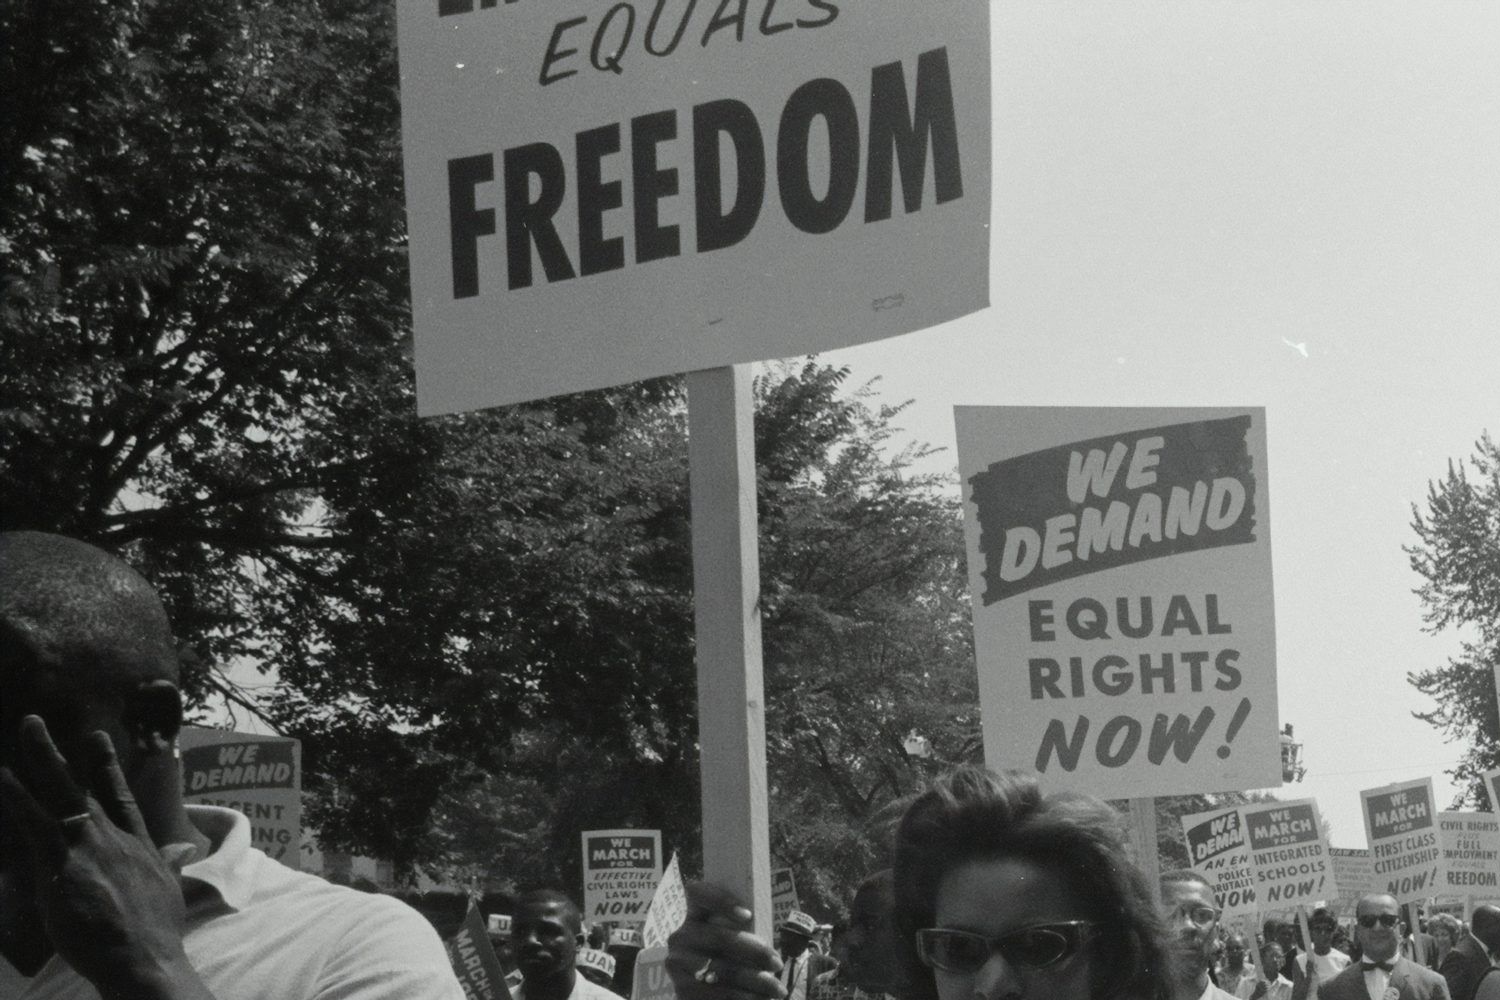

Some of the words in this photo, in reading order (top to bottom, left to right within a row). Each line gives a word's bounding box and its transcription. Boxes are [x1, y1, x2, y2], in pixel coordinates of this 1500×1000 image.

[448, 46, 964, 299] FREEDOM
[1067, 436, 1164, 503] WE
[1000, 477, 1245, 582] DEMAND
[1028, 594, 1232, 642] EQUAL
[1028, 649, 1242, 699] RIGHTS
[1035, 697, 1252, 773] NOW!
[218, 745, 259, 765] WE
[190, 763, 290, 790] DEMAND
[1390, 793, 1407, 806] WE
[1211, 813, 1236, 835] WE
[1269, 810, 1291, 822] WE
[1375, 802, 1426, 827] MARCH
[1254, 819, 1312, 840] MARCH
[1393, 822, 1413, 833] FOR
[1441, 821, 1463, 831] CIVIL
[1467, 821, 1499, 832] RIGHTS
[611, 838, 631, 847] WE
[1197, 829, 1243, 860] DEMA
[1274, 835, 1297, 845] FOR
[1374, 840, 1403, 858] FIRST
[1406, 833, 1436, 850] CLASS
[1457, 840, 1481, 850] FULL
[593, 848, 651, 861] MARCH
[1205, 859, 1225, 871] AN
[1230, 855, 1248, 866] EN
[1254, 845, 1322, 866] INTEGRATED
[1374, 848, 1440, 874] CITIZENSHIP
[594, 871, 654, 880] EFFECTIVE
[1218, 868, 1252, 882] POLICE
[1258, 861, 1325, 882] SCHOOLS
[1447, 871, 1497, 886] REEDOM
[587, 882, 614, 891] CIVIL
[617, 881, 658, 890] RIGHTS
[606, 891, 639, 899] LAWS
[1268, 875, 1325, 903] NOW!
[455, 928, 490, 991] MARCH
